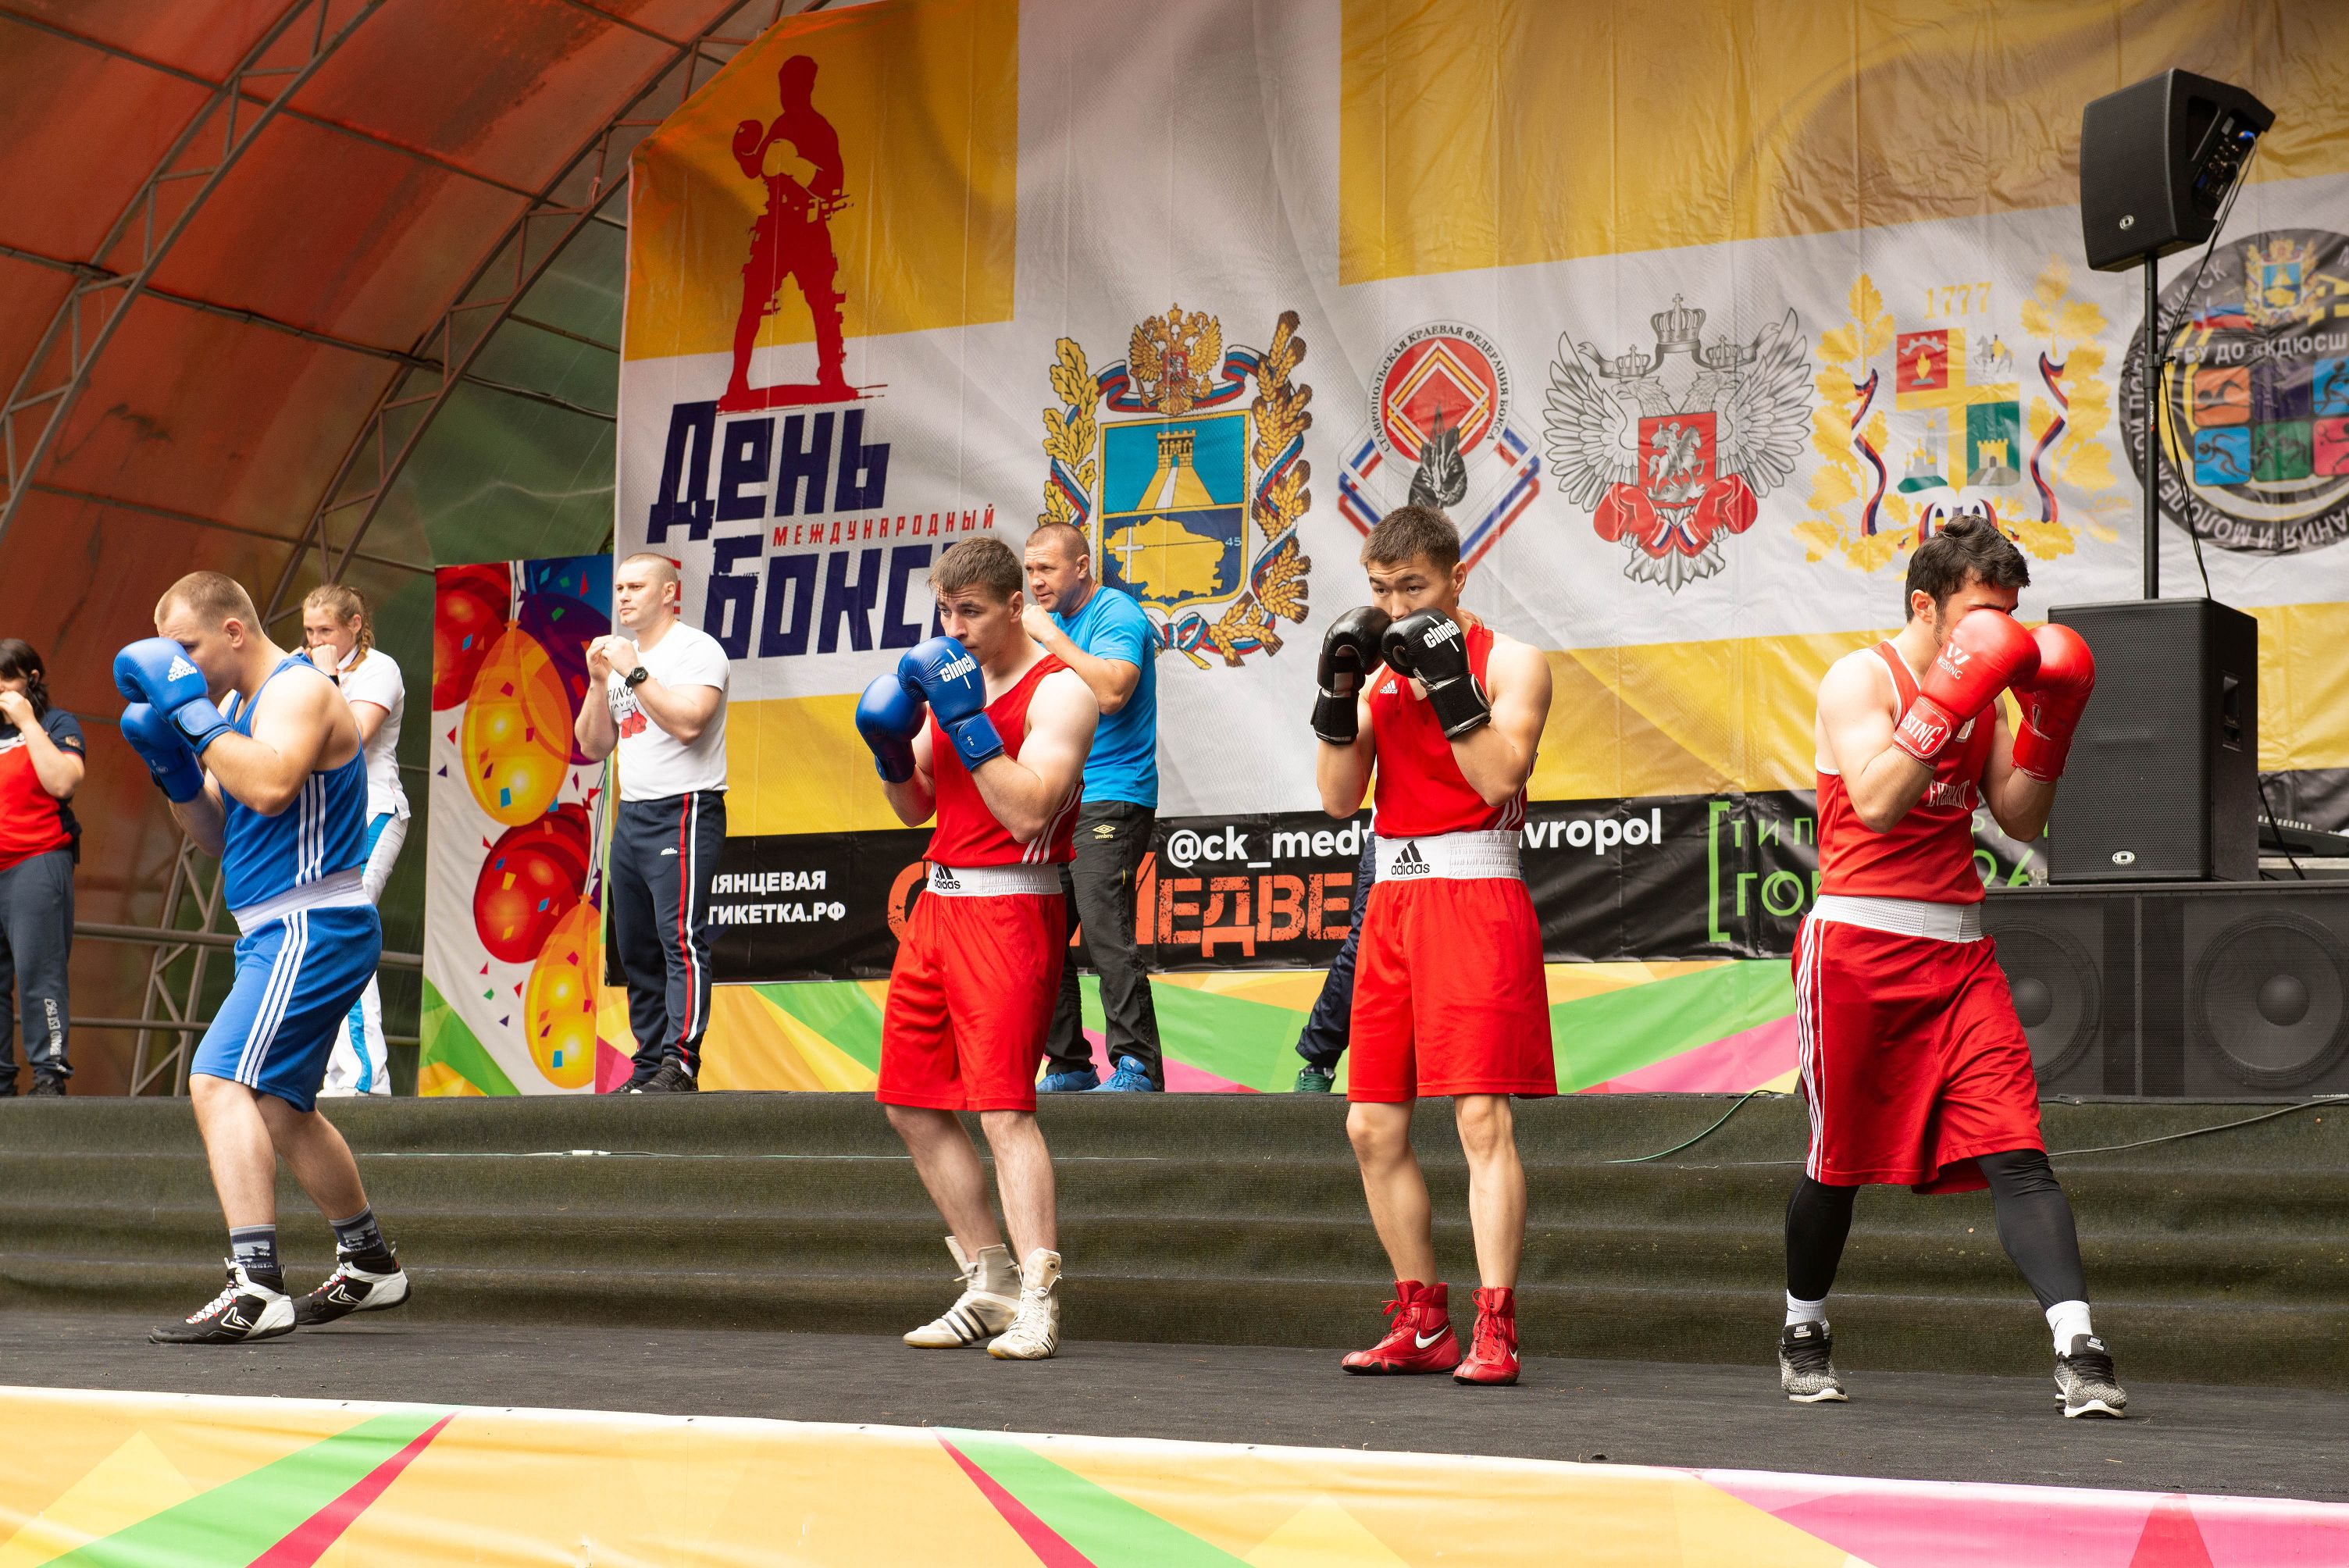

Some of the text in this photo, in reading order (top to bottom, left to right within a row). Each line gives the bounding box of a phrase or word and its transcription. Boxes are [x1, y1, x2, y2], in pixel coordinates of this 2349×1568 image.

[1924, 281, 1991, 319] 1777
[2215, 342, 2245, 365] ДО
[1371, 325, 1510, 453] СТАВРОПОЛЬСКАЯ КРАЕВАЯ ФЕДЕРАЦИЯ БОКСА
[772, 503, 996, 547] МЕЖДУНАРОДНЫЙ
[2283, 508, 2349, 548] АНИЯ
[1224, 536, 1242, 547] 45
[1423, 618, 1461, 649] clinch
[939, 653, 977, 682] clinch
[1936, 654, 1964, 680] WESING
[1899, 708, 1944, 752] ESING
[1925, 779, 1970, 811] EVERLAST
[711, 870, 826, 896] ЯНЦЕВАЯ
[1391, 861, 1431, 875] adidas
[708, 901, 847, 926] ТИКЕТКА.РФ
